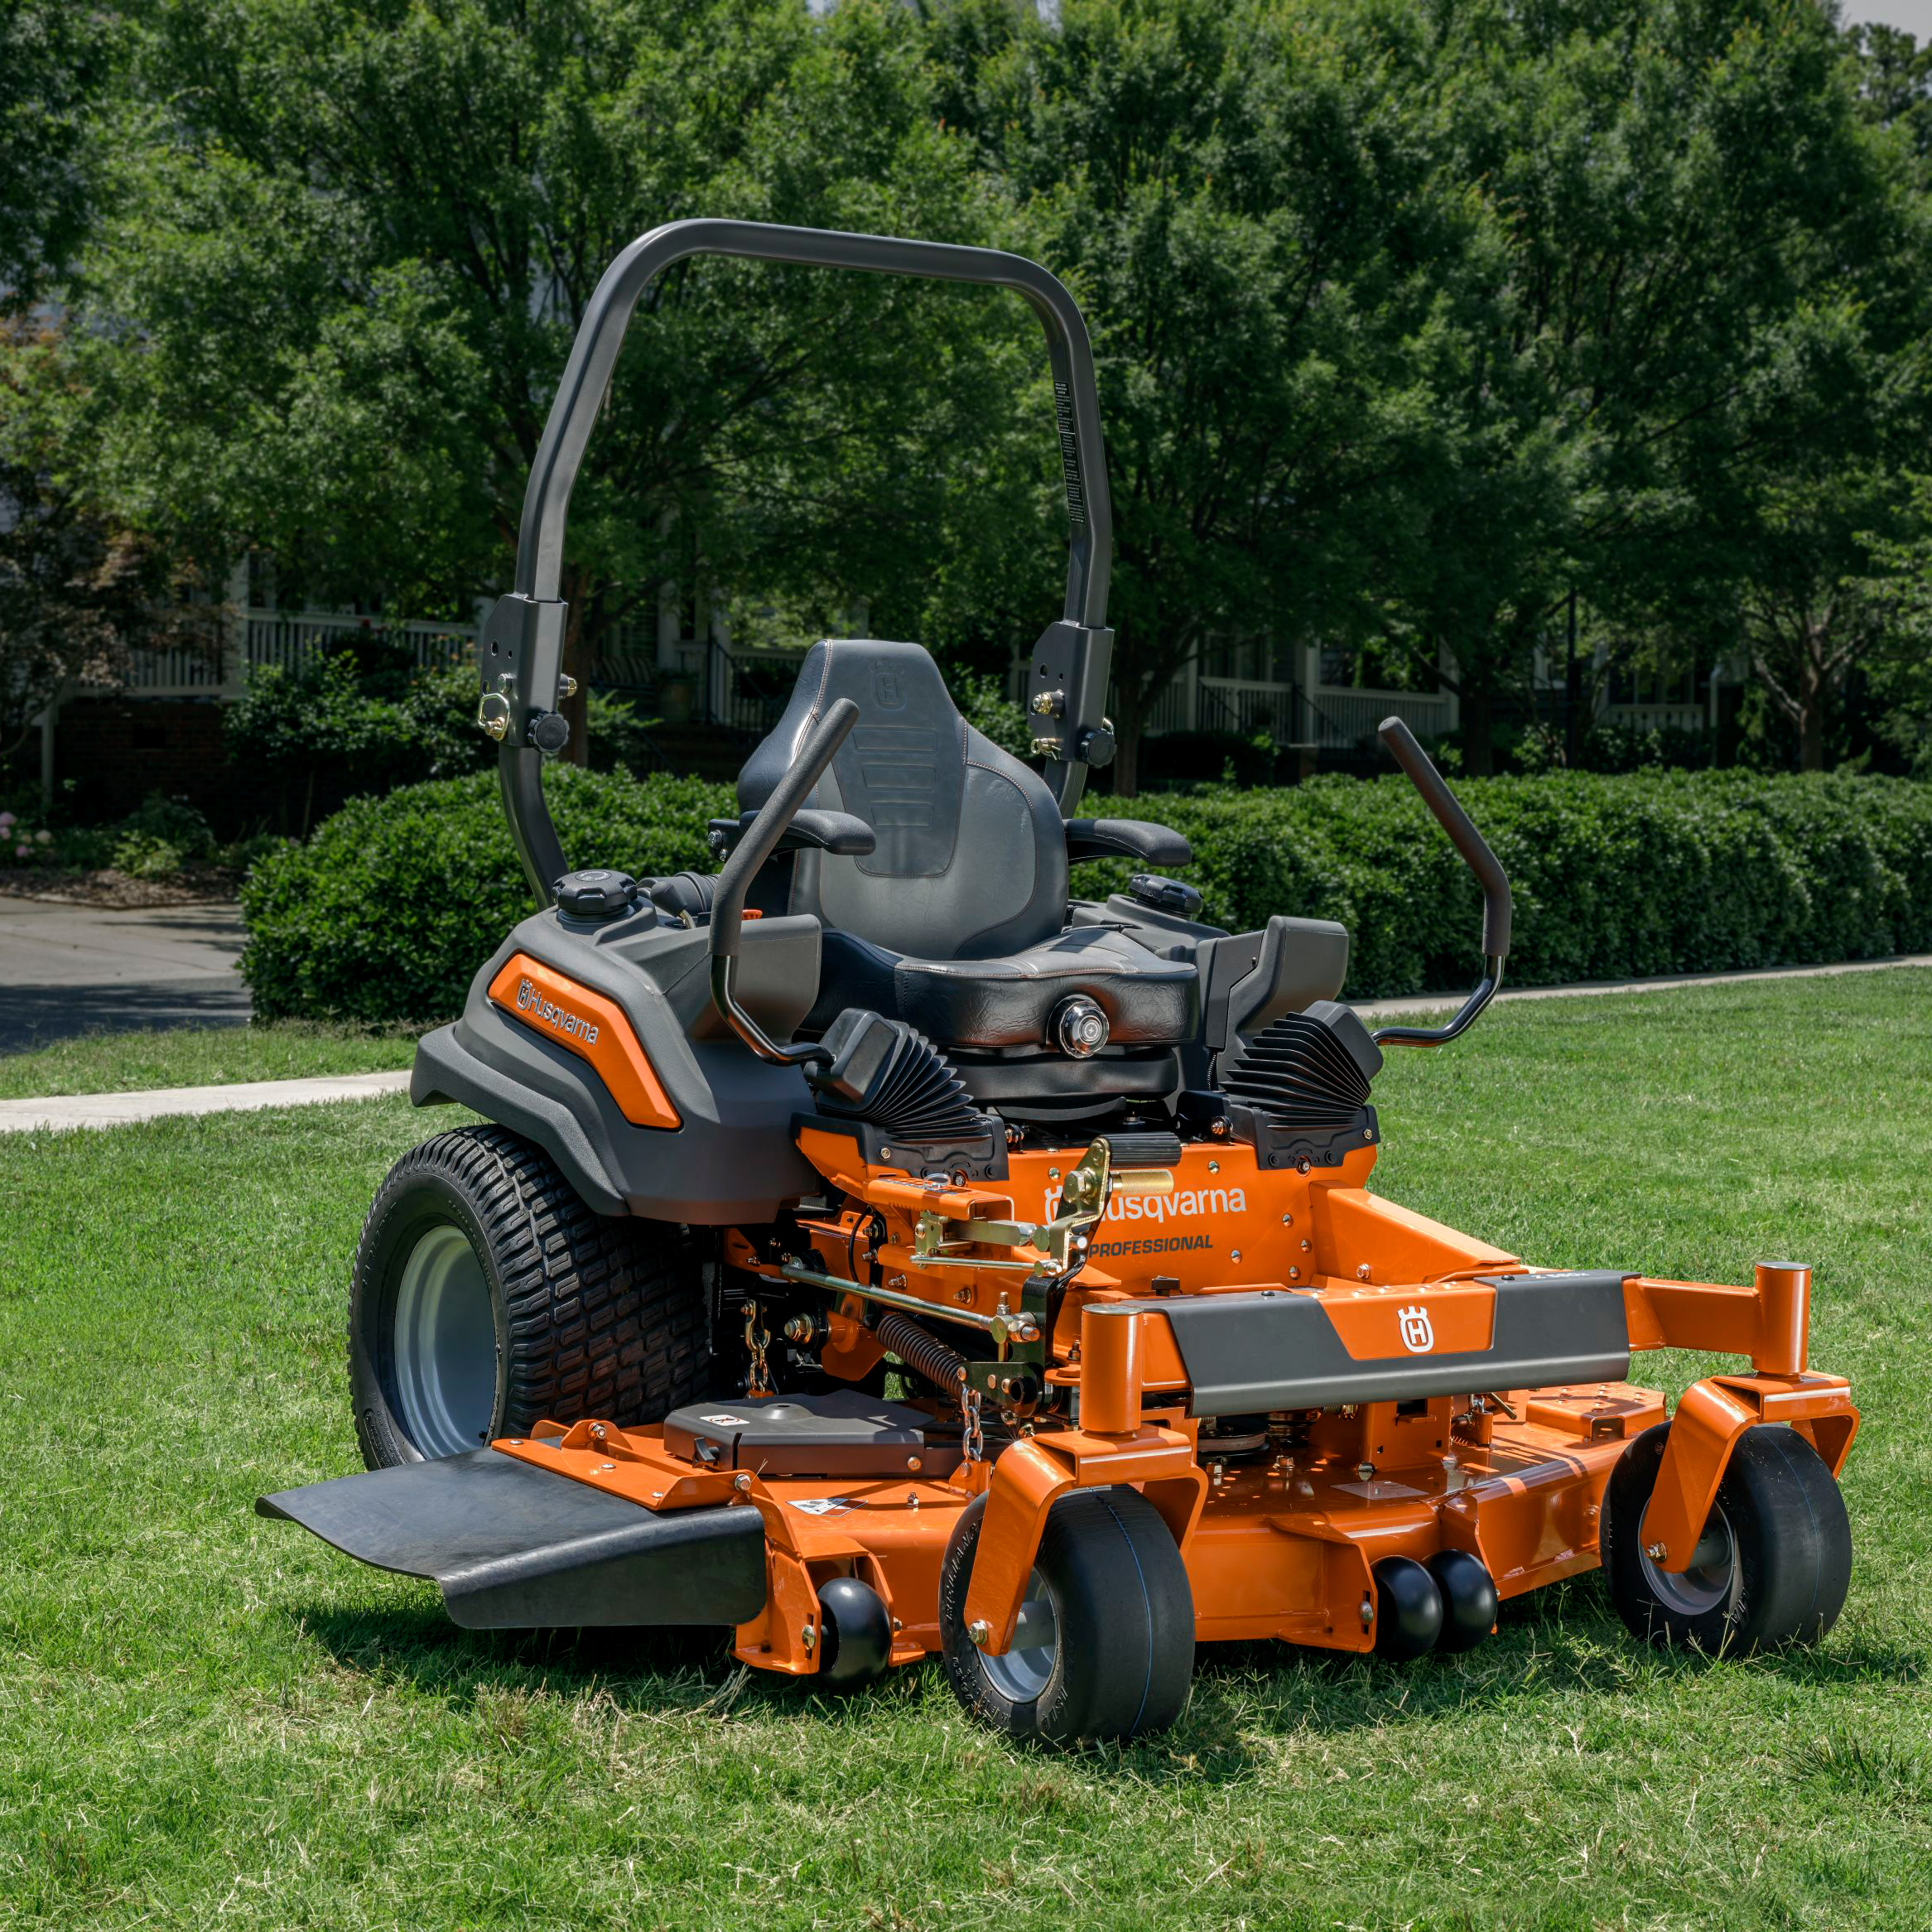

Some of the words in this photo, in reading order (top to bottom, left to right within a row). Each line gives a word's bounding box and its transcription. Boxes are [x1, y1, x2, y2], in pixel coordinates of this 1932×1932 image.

[528, 988, 599, 1045] Husqvarna
[1101, 1188, 1247, 1223] usqvarna
[1089, 1235, 1213, 1258] PROFESSIONAL
